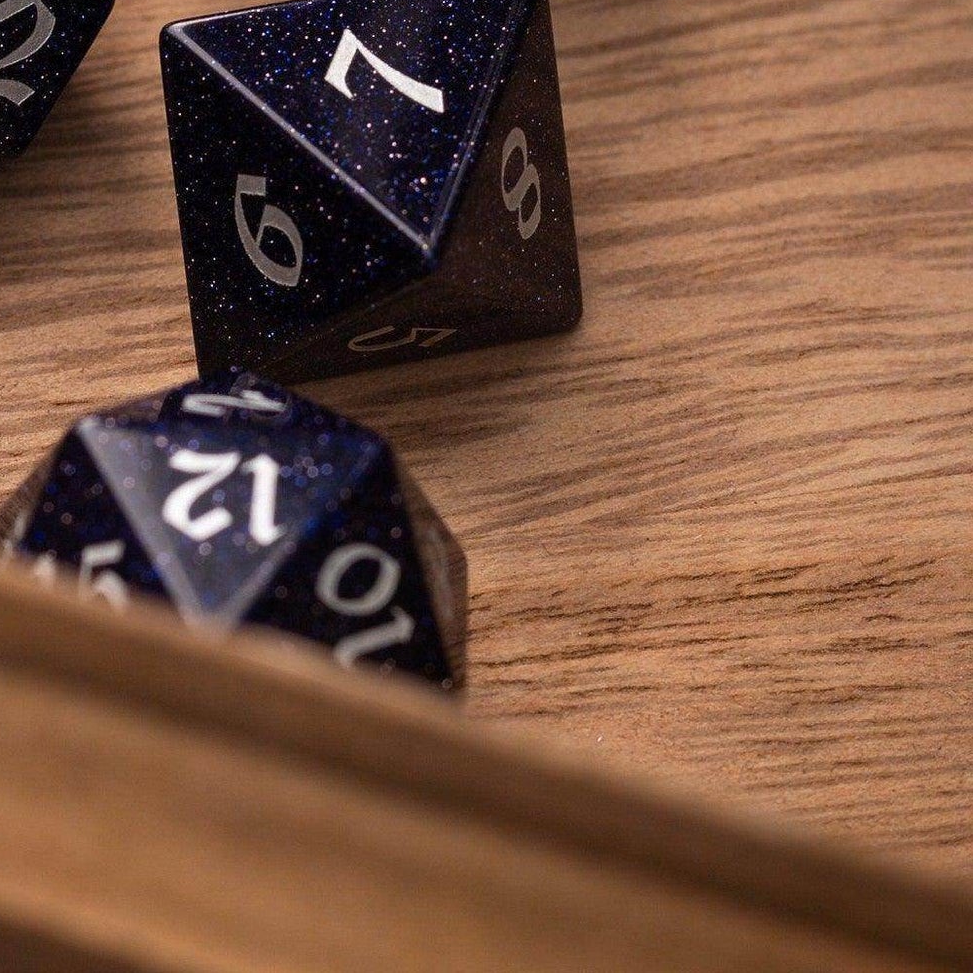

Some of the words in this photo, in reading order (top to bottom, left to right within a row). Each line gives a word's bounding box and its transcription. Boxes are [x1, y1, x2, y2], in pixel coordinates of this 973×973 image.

[324, 28, 444, 113] 7
[234, 174, 303, 287] 6
[501, 127, 541, 240] 8
[348, 326, 457, 352] 5
[162, 448, 287, 547] 12
[316, 542, 416, 668] 10
